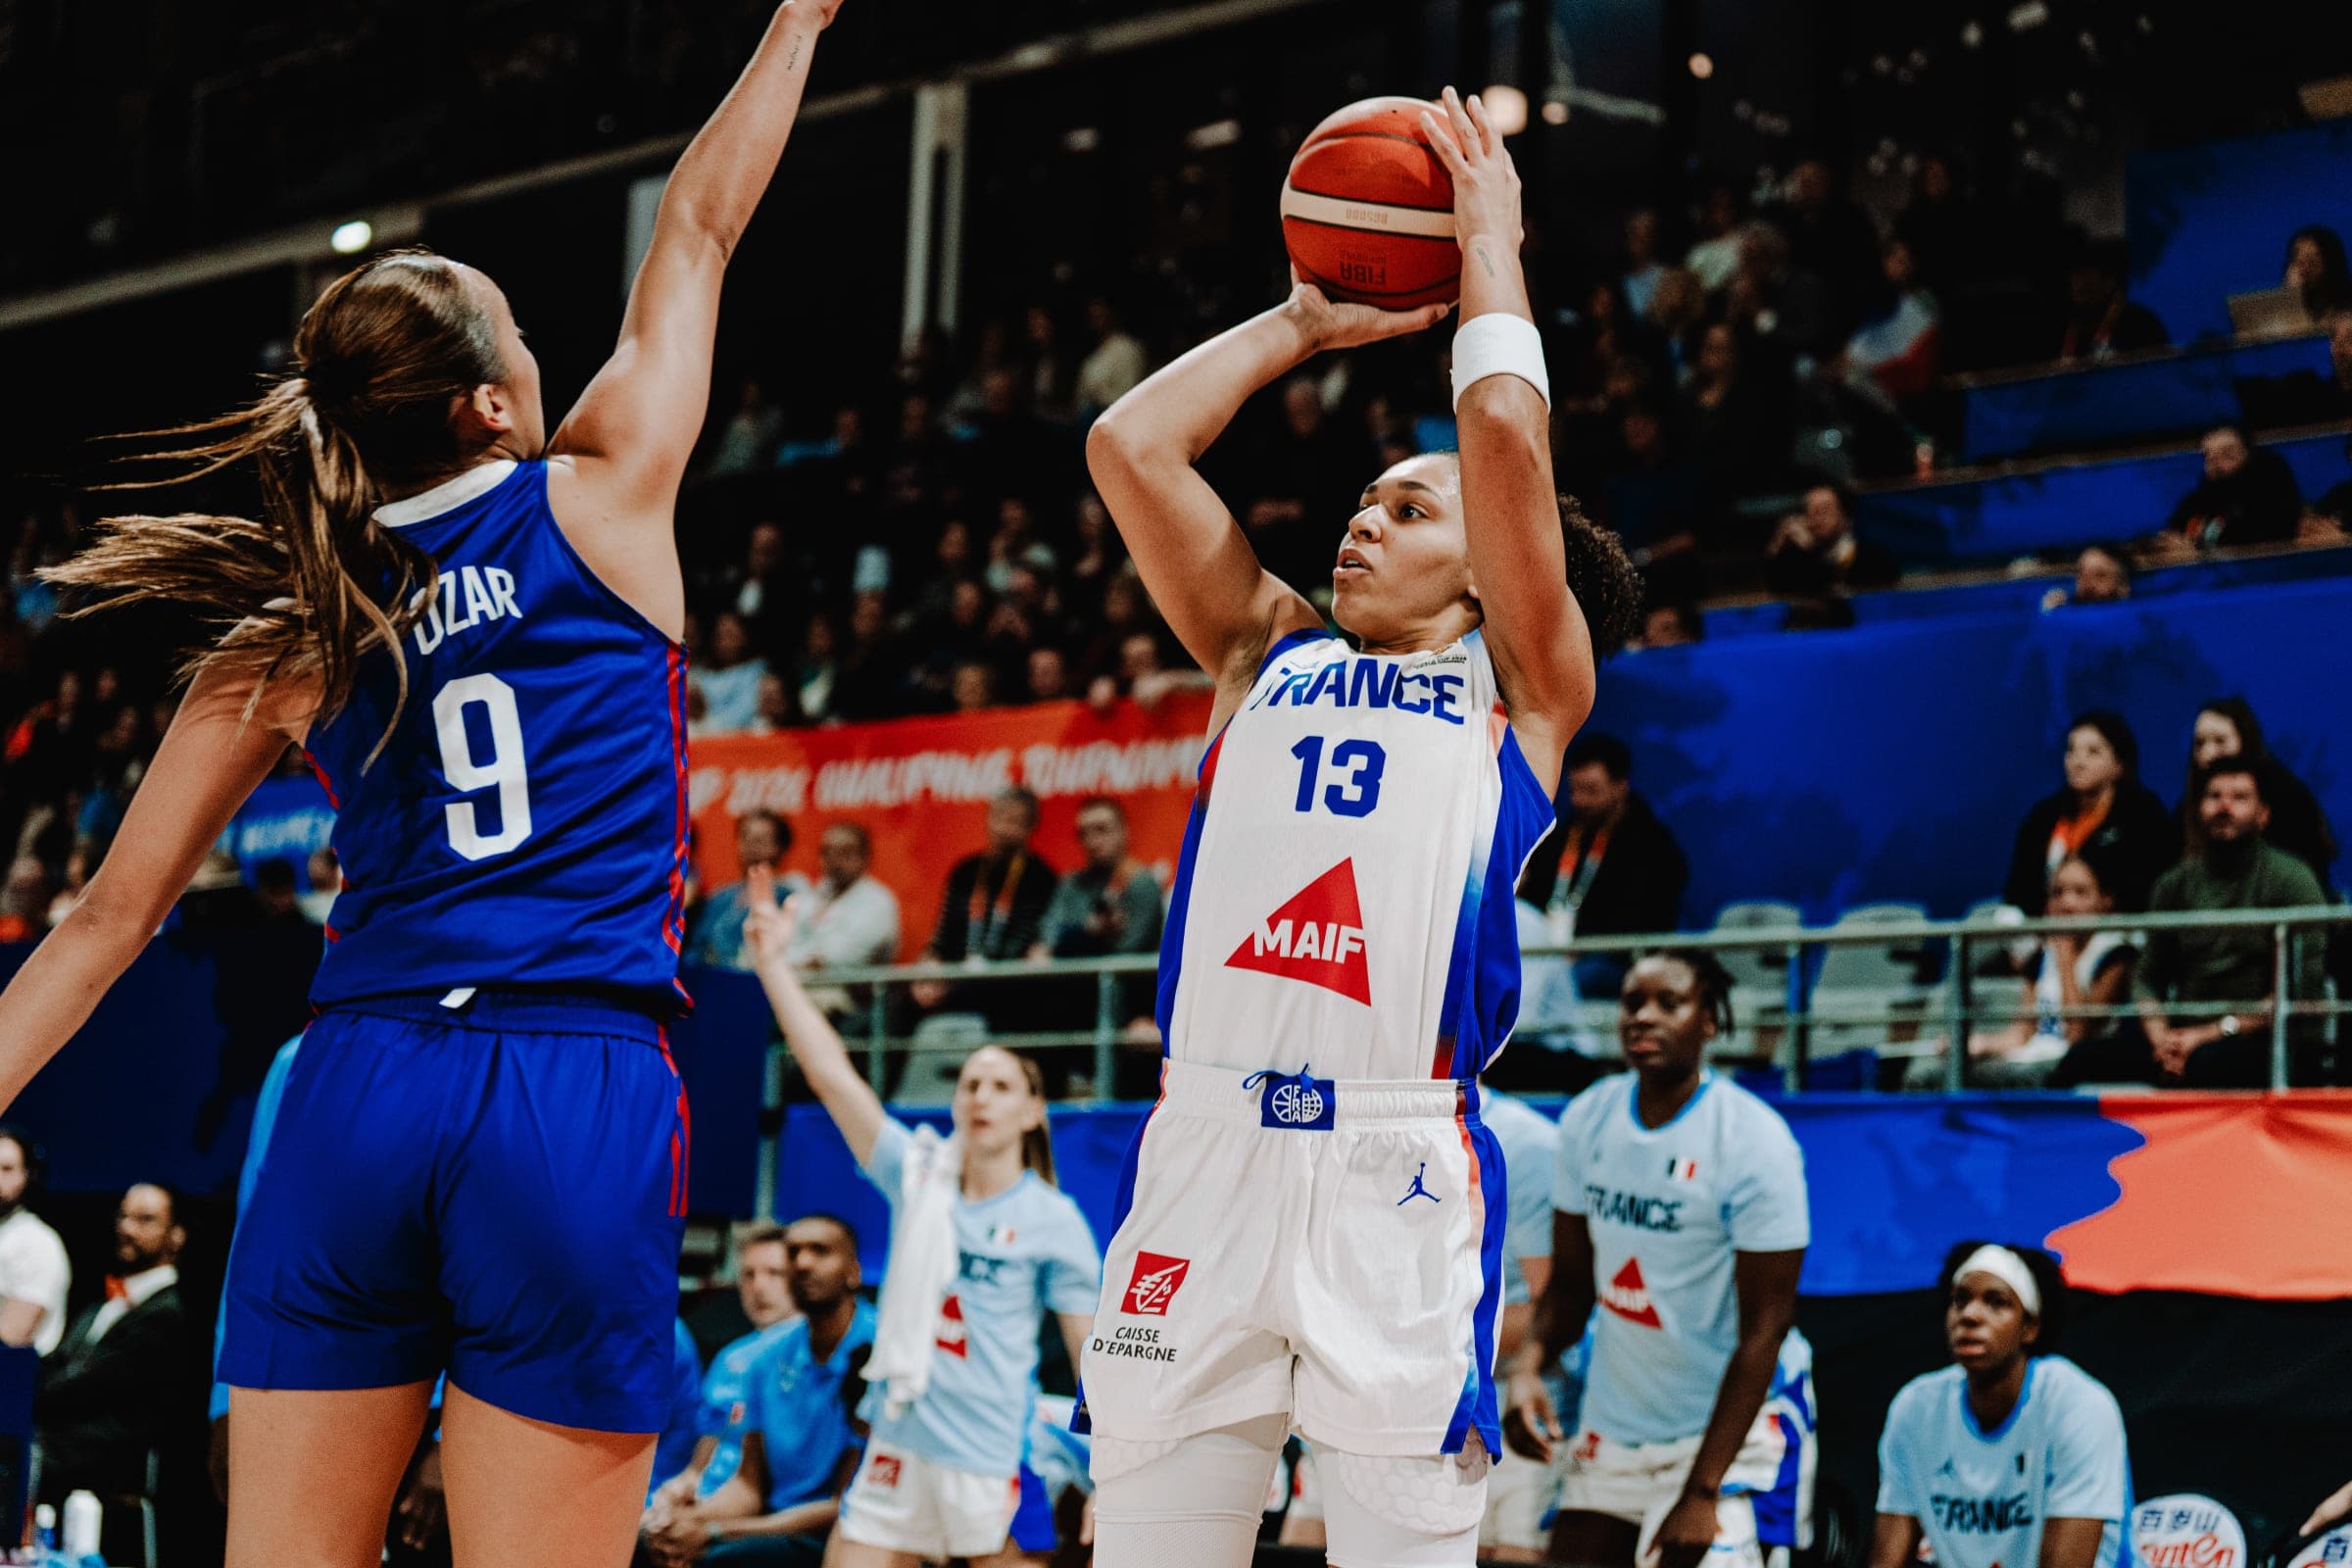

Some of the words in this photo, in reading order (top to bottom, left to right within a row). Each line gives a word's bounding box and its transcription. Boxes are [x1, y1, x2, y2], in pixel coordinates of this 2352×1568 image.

[1340, 262, 1387, 285] FIBA
[432, 673, 532, 861] 9
[1291, 735, 1387, 817] 13
[1253, 918, 1364, 964] MAIF
[1092, 1339, 1177, 1362] D'EPARGNE
[1115, 1327, 1160, 1343] CAISSE
